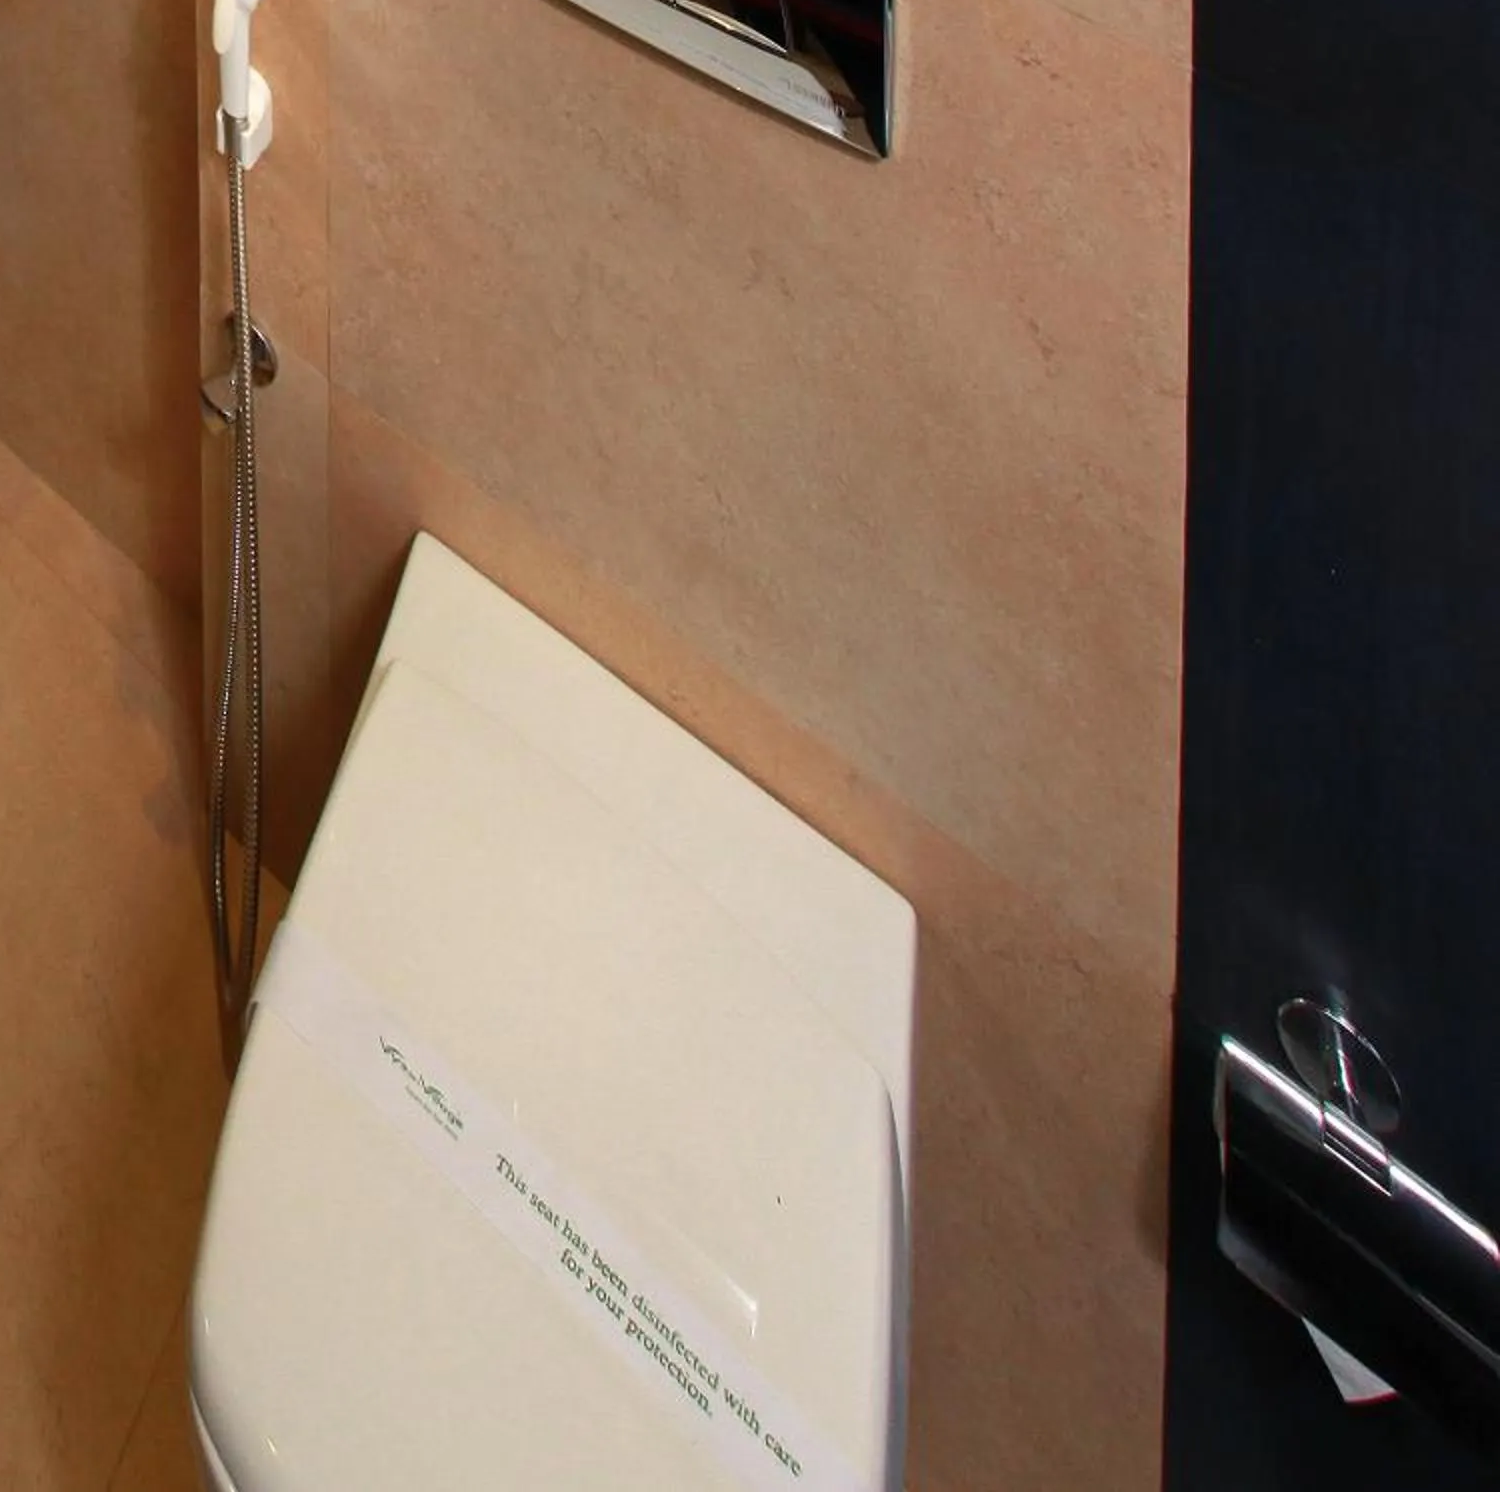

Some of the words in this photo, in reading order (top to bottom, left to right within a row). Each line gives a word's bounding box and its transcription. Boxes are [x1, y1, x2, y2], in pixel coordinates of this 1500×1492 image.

[496, 1153, 527, 1194] This
[529, 1193, 560, 1228] seat
[561, 1219, 590, 1256] has
[591, 1249, 628, 1297] been
[631, 1293, 720, 1391] disinfected
[723, 1386, 761, 1436] with
[764, 1432, 802, 1477] care
[560, 1248, 584, 1280] for
[585, 1276, 625, 1321] your
[624, 1316, 713, 1419] protection.
